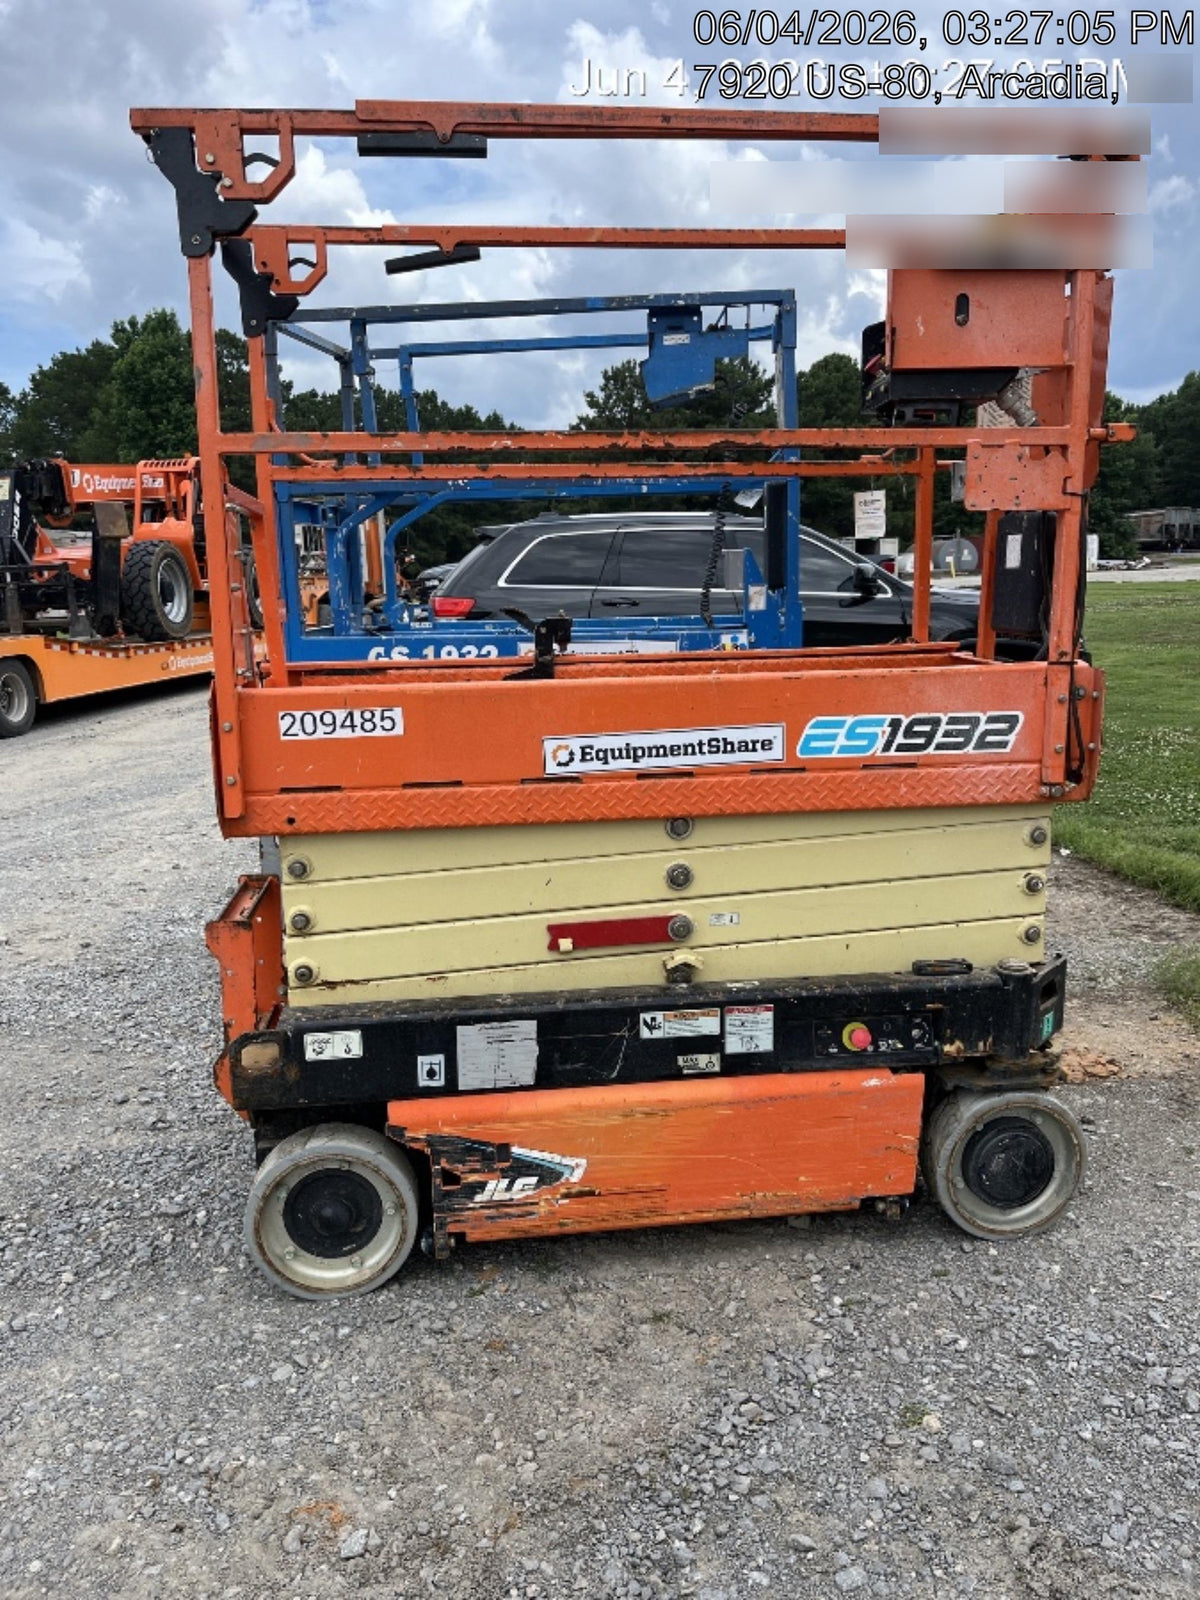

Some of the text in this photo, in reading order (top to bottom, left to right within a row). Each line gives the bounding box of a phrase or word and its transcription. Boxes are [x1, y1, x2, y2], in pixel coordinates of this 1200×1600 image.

[280, 708, 396, 737] 209485
[798, 713, 1022, 757] ES1932
[579, 735, 776, 765] EquipmentShare
